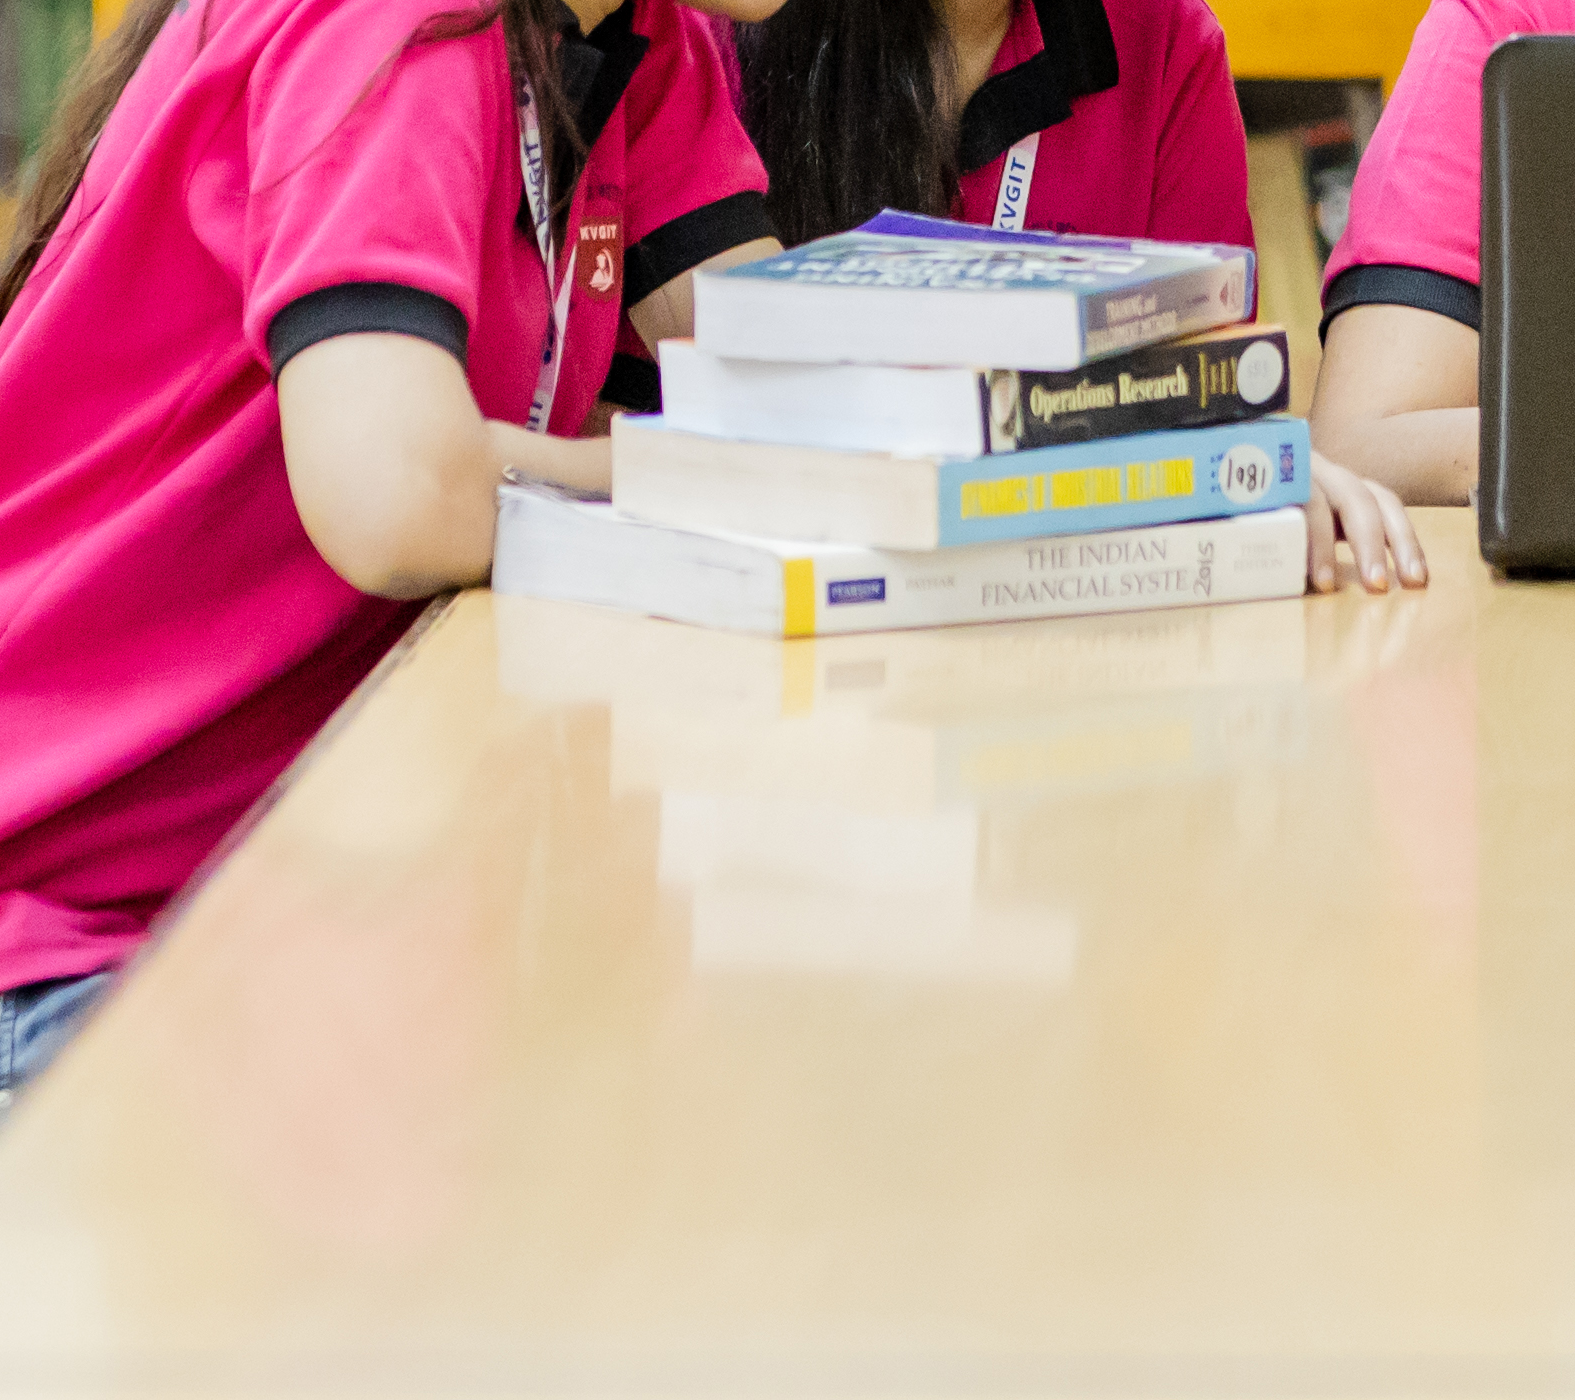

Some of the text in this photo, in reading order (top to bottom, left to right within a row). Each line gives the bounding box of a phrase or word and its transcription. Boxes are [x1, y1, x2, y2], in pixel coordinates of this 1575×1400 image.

[1030, 378, 1115, 423] Operations
[1118, 363, 1188, 404] Research
[1225, 458, 1267, 491] 1081
[1025, 537, 1168, 572] THE INDIAN
[981, 568, 1189, 608] FINANCIAL SYSTE
